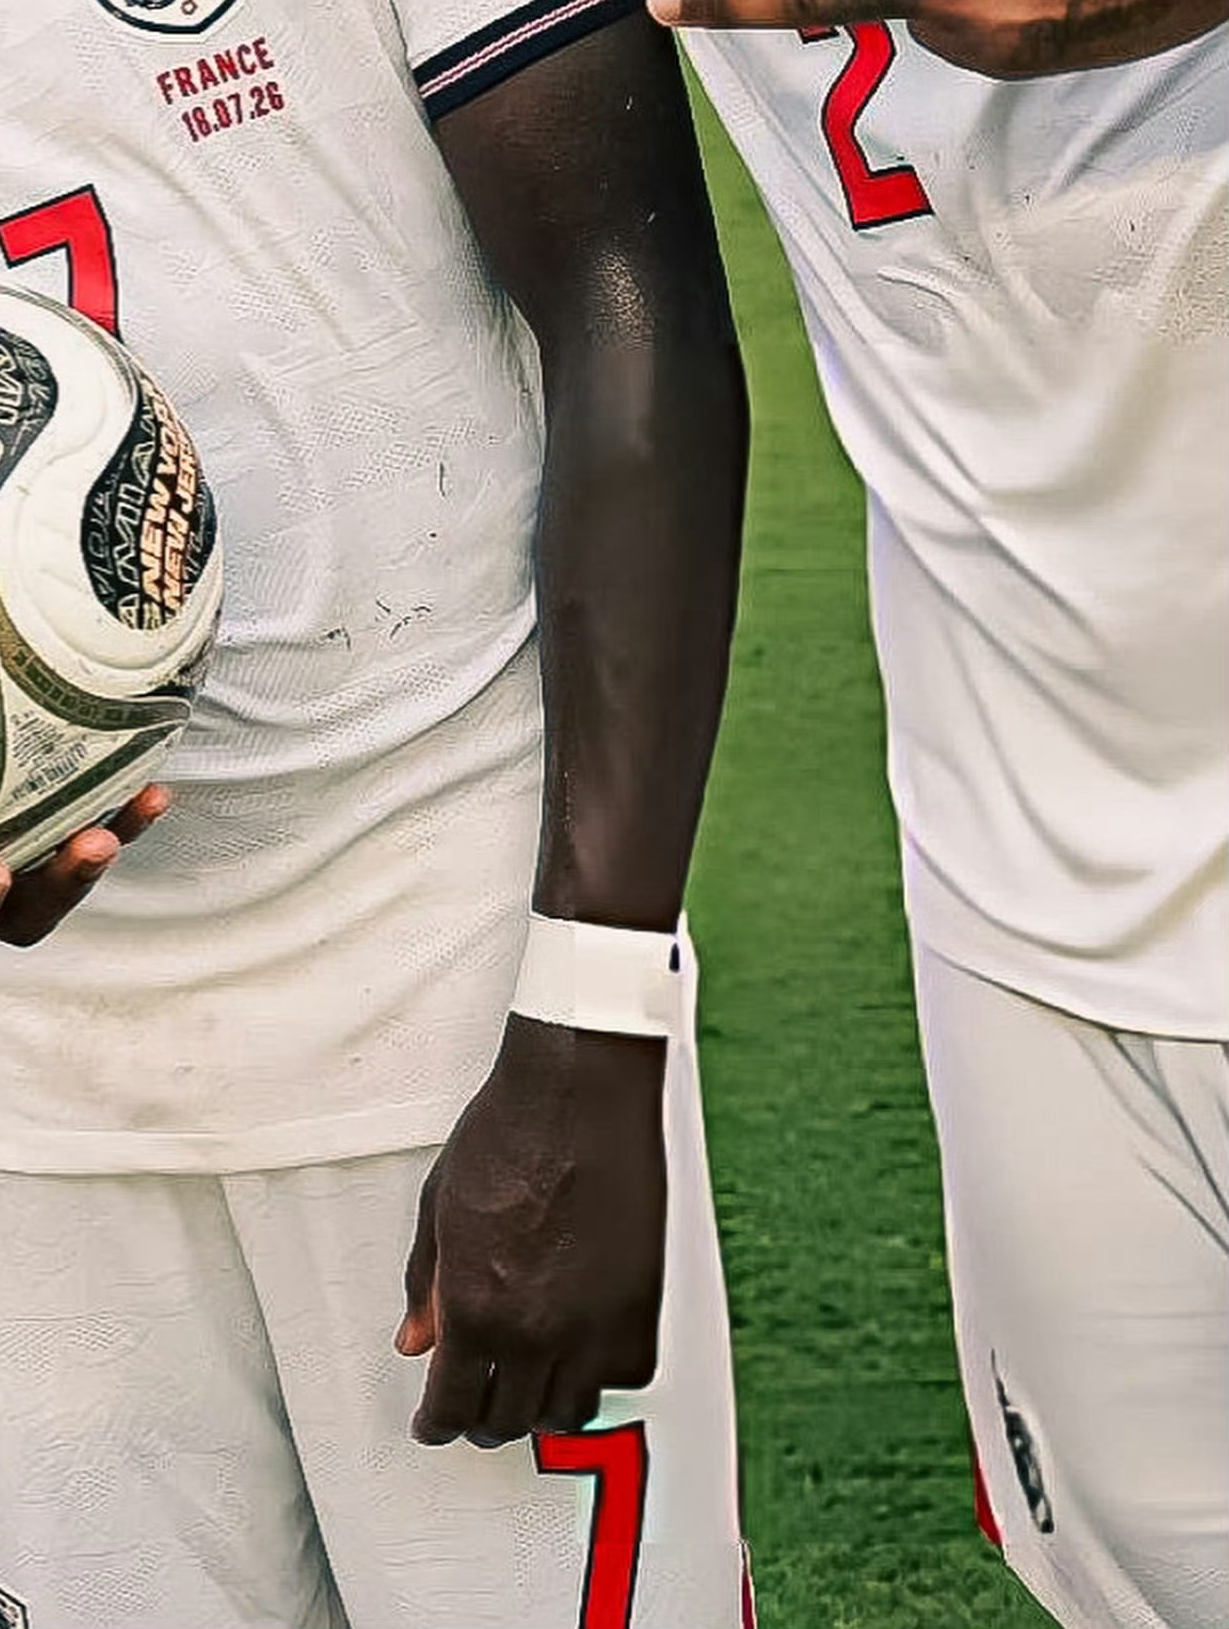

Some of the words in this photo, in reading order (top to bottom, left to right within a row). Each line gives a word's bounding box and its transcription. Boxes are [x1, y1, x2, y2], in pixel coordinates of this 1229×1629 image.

[156, 37, 274, 105] FRANCE
[181, 81, 284, 143] 18.07.26
[797, 19, 936, 231] 2
[140, 476, 171, 602] NEW
[531, 1419, 650, 1629] 7
